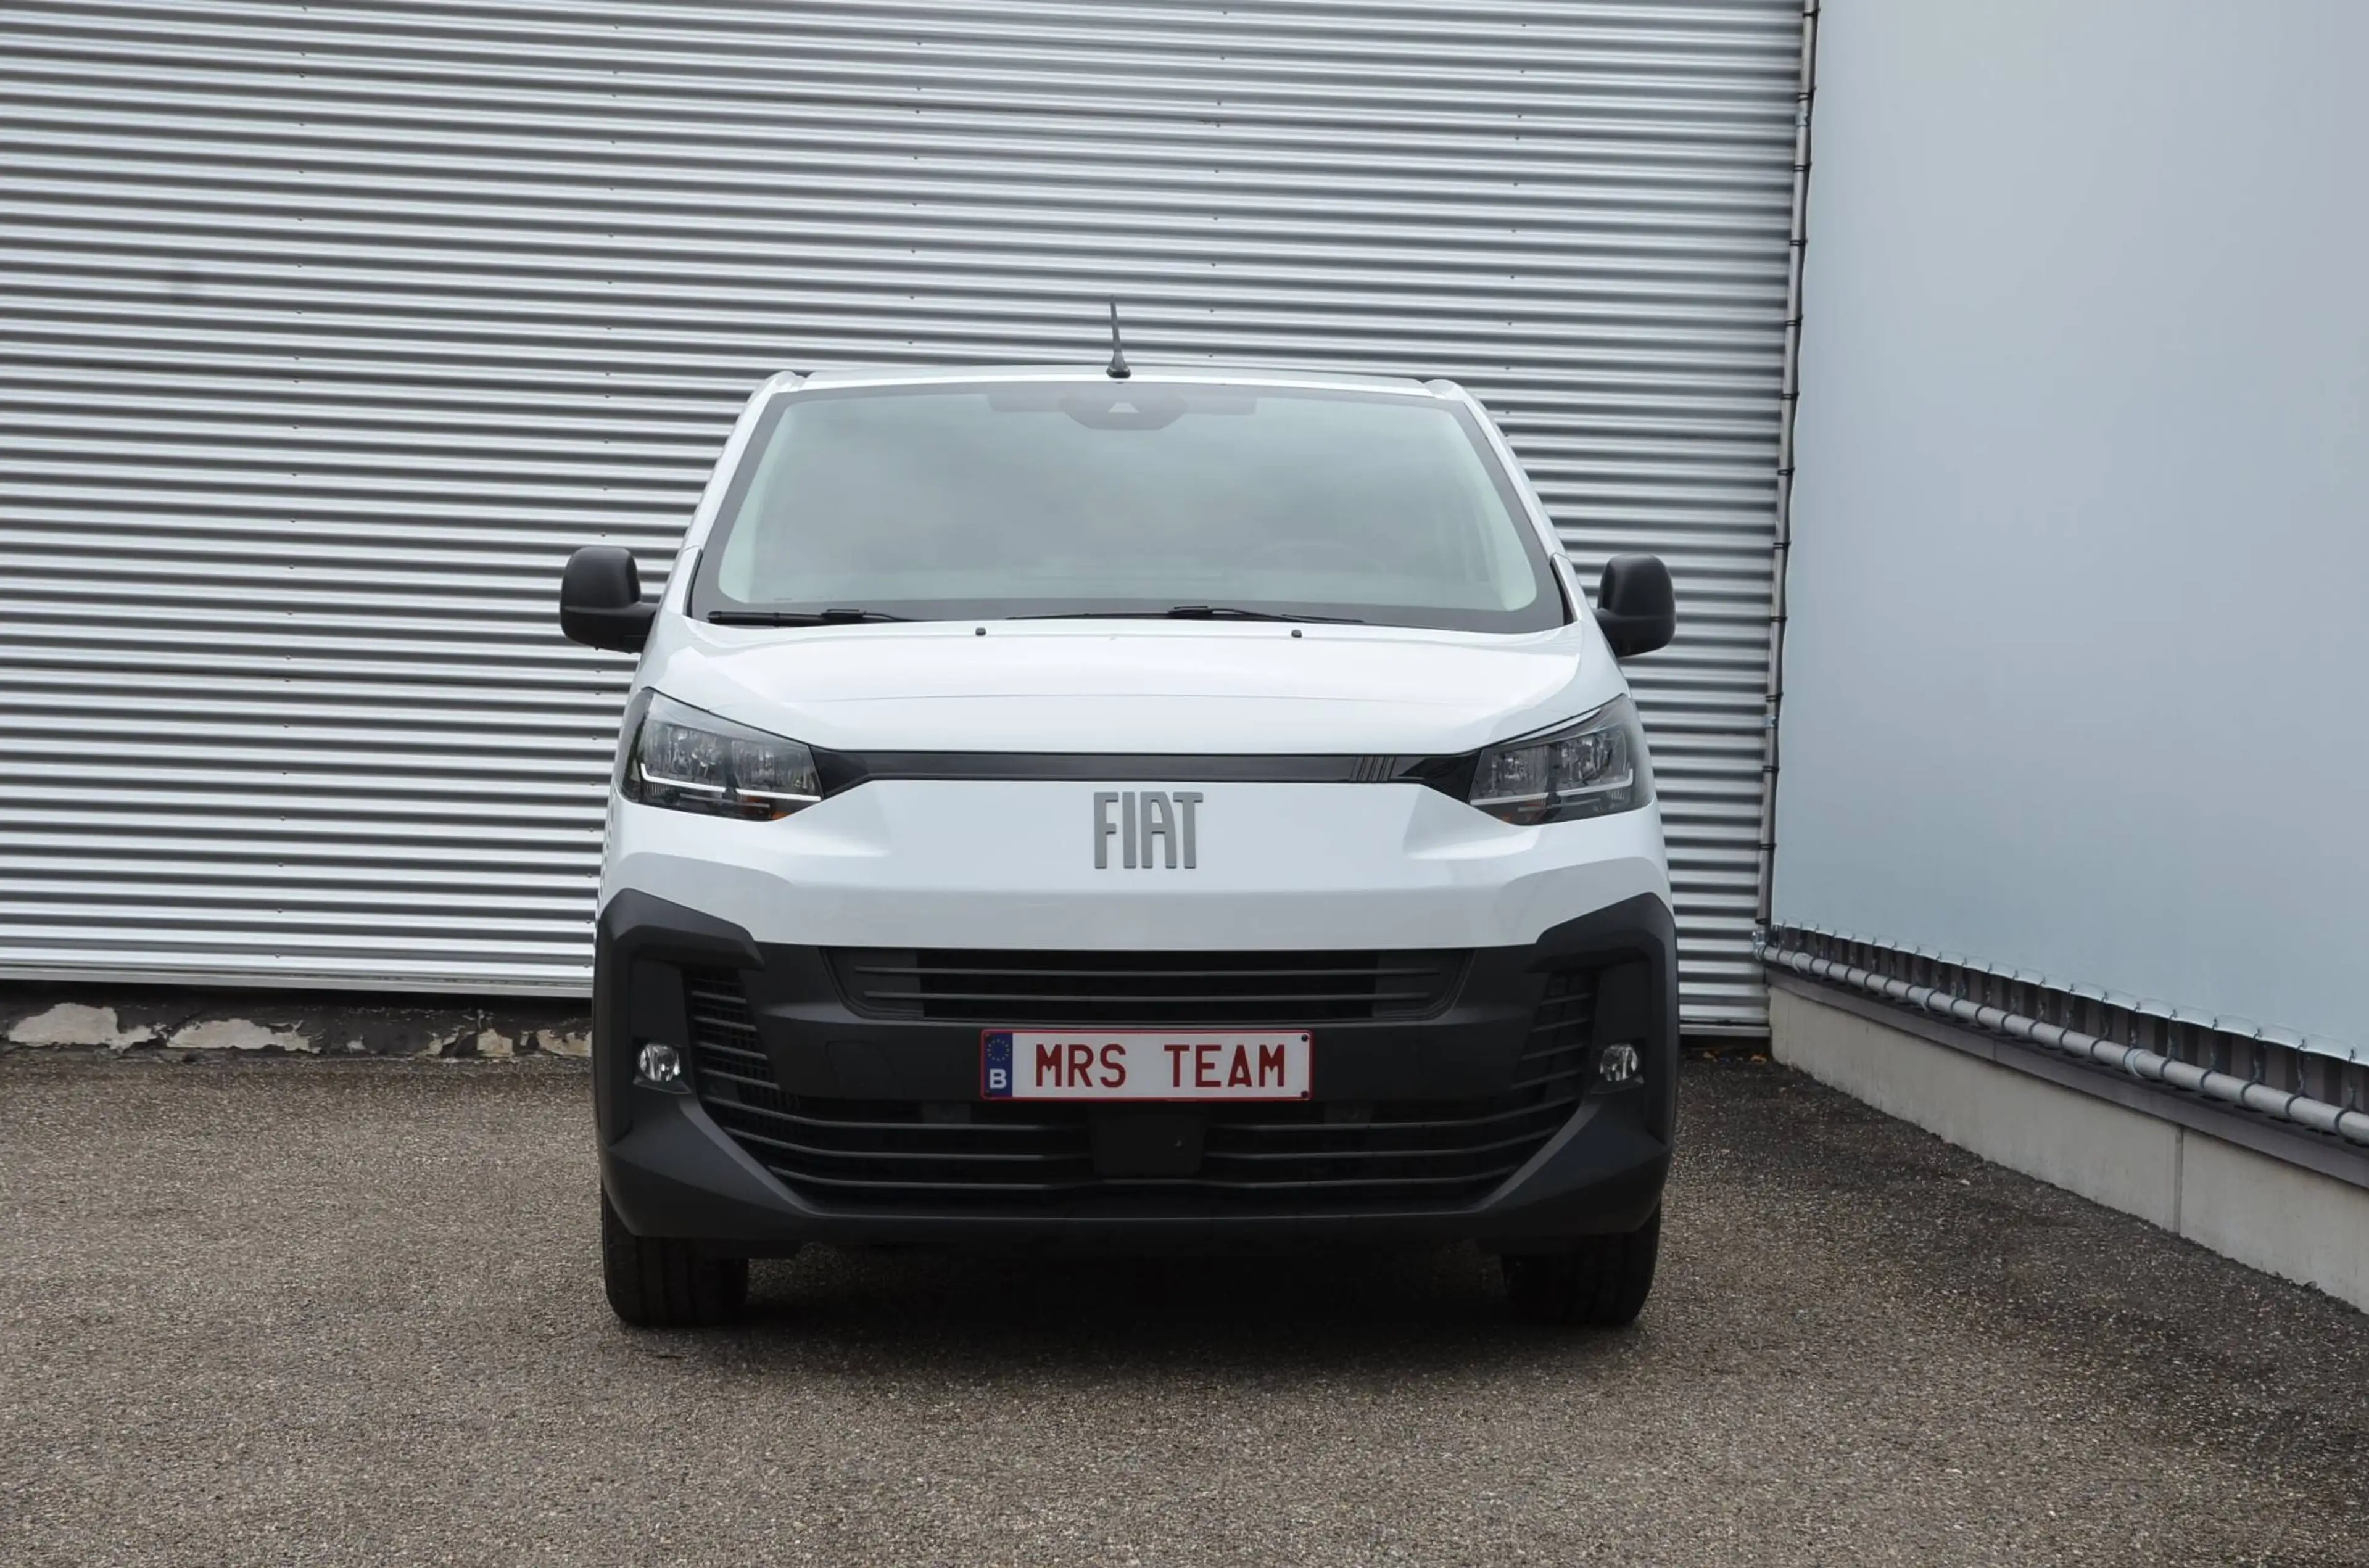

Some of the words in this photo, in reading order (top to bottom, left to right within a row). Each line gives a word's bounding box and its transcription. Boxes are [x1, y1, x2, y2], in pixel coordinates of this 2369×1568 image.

[1094, 792, 1203, 869] FIAT
[989, 1069, 1007, 1089] B
[1035, 1044, 1127, 1088] MRS
[1164, 1044, 1285, 1087] TEAM
